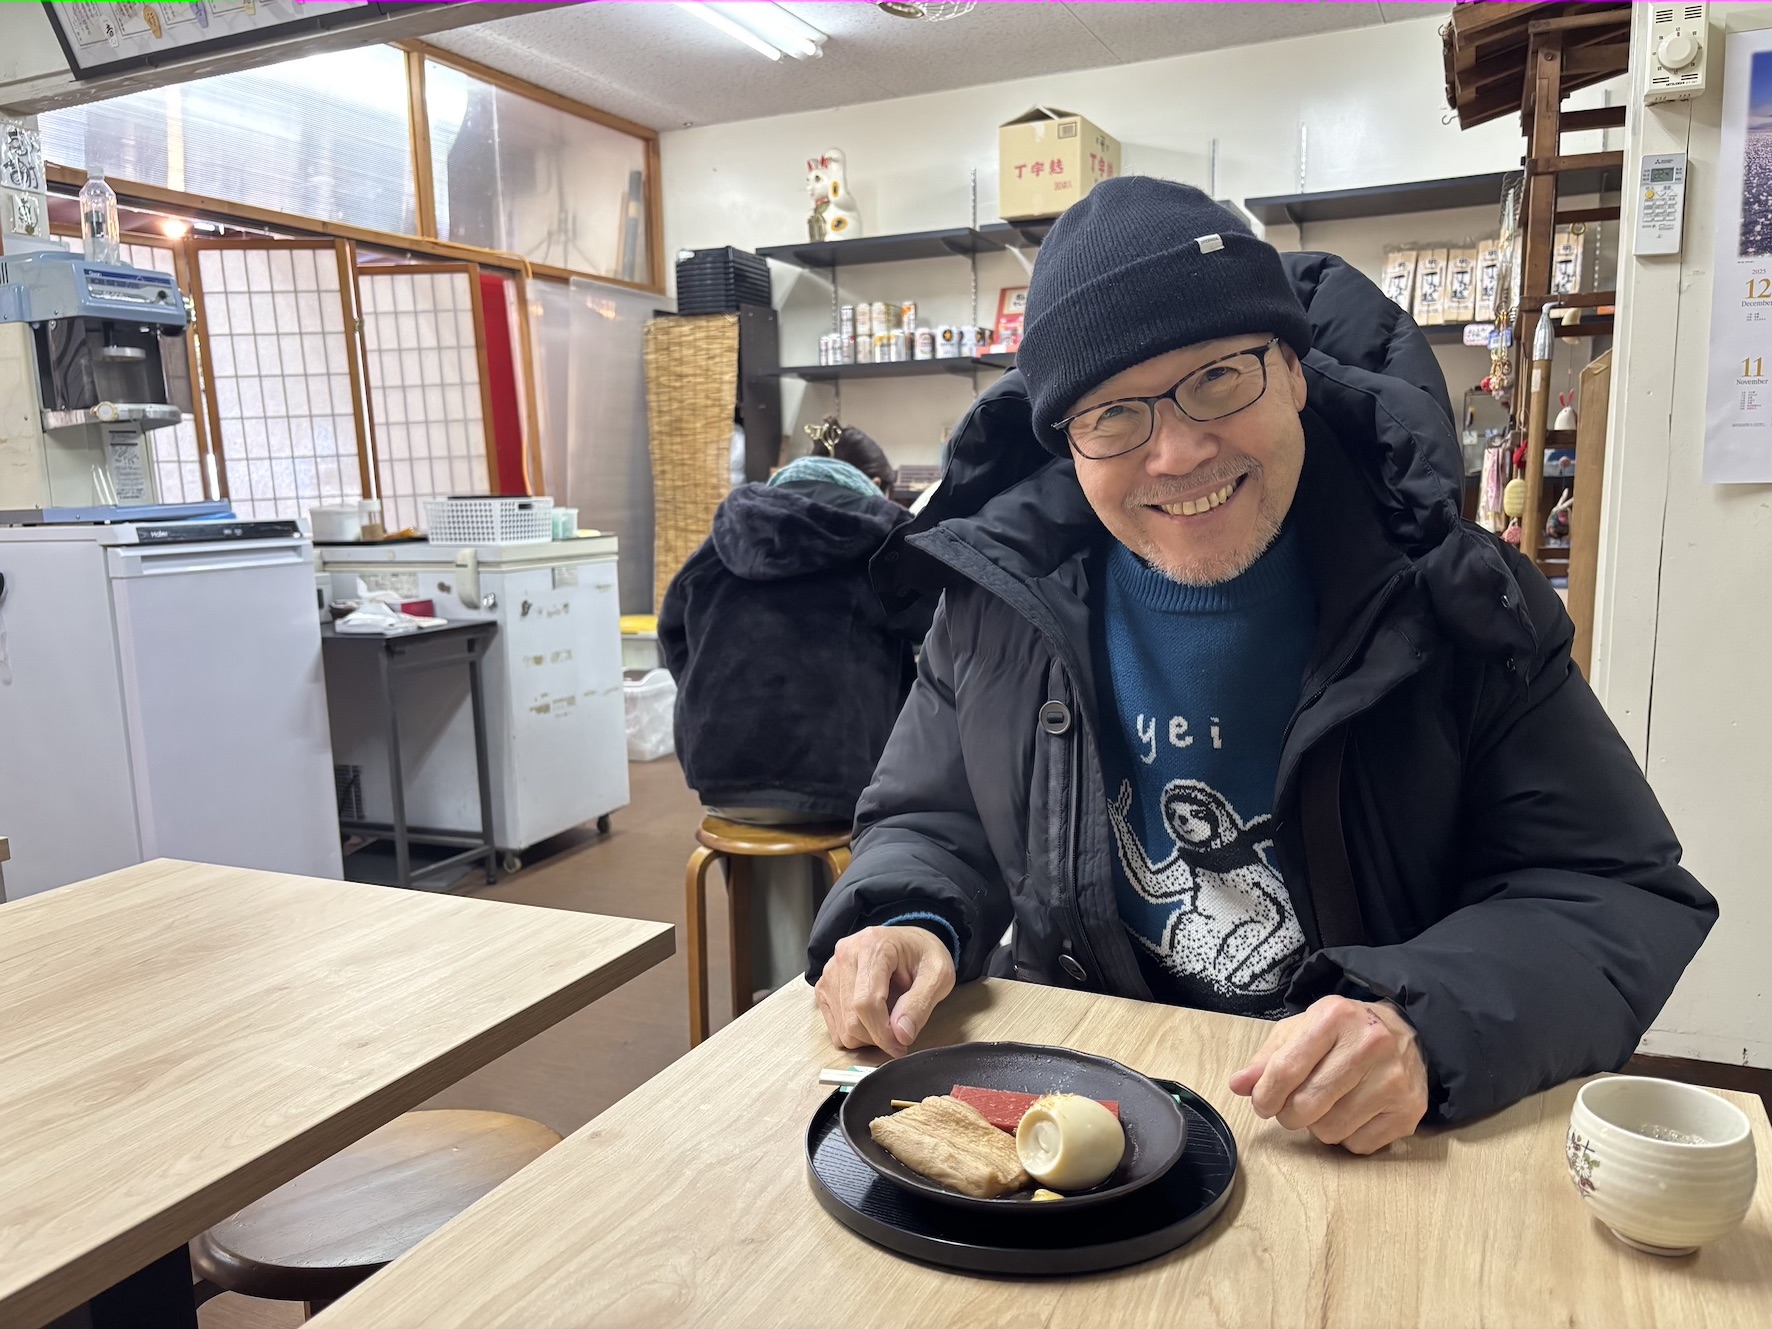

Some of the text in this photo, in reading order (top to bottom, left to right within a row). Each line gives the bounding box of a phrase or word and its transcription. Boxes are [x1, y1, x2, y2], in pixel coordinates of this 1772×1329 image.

[1746, 278, 1772, 298] 12
[1741, 357, 1764, 377] 11
[1736, 378, 1769, 386] November
